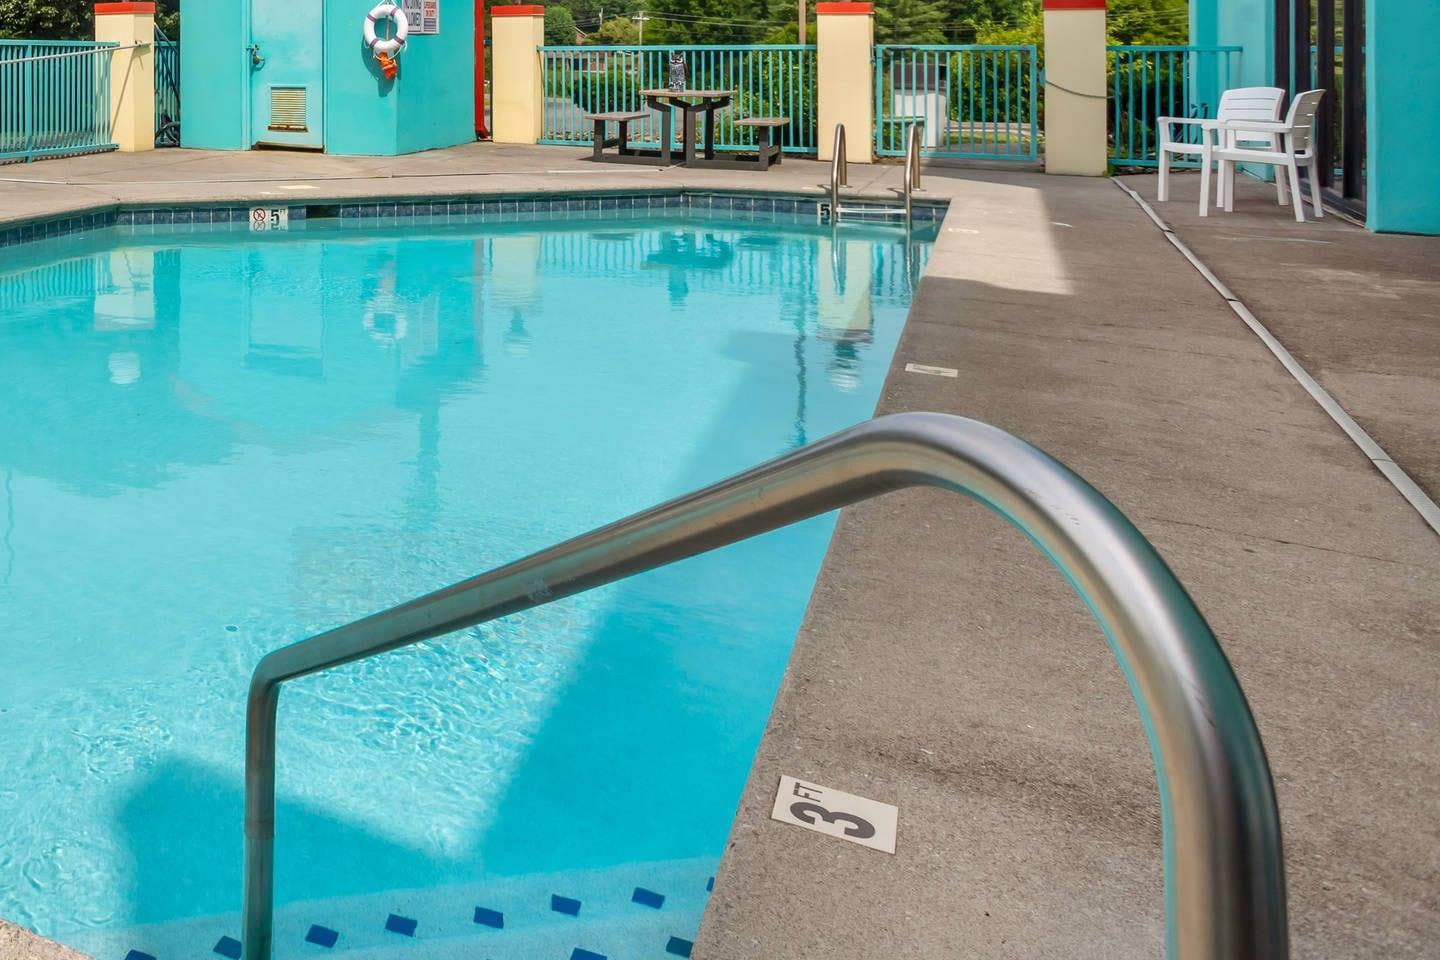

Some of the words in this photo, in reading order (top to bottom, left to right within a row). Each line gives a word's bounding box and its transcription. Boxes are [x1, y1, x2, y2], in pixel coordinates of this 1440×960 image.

[271, 209, 279, 221] 5
[821, 204, 830, 216] 5
[793, 782, 823, 802] FT
[790, 802, 875, 839] 3
